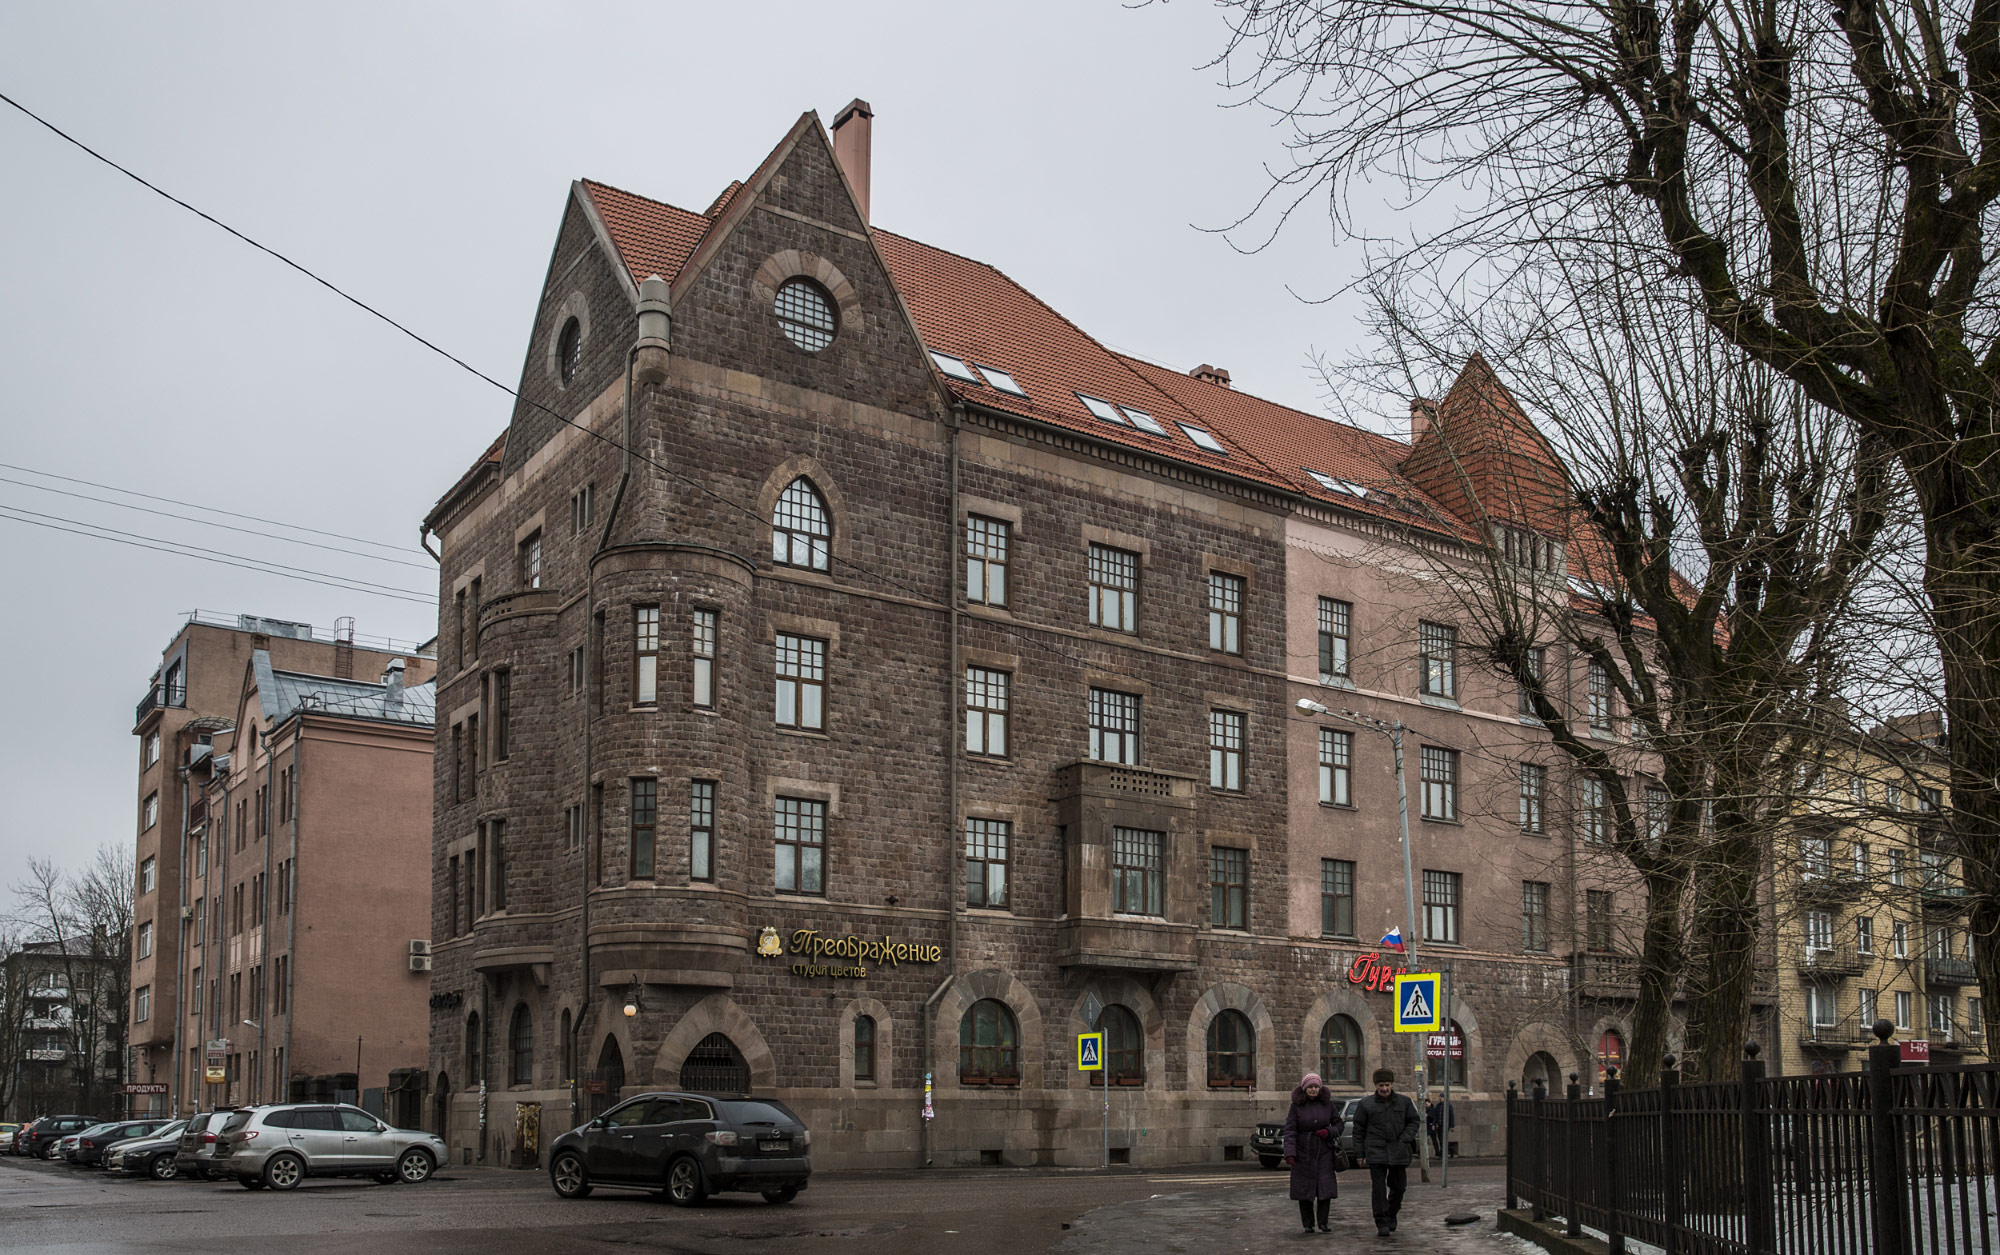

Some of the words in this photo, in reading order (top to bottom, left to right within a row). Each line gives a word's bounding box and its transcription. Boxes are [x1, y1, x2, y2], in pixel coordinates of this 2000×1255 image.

[790, 929, 941, 966] Преображение
[792, 963, 828, 977] студия
[830, 966, 866, 979] цветов
[126, 1084, 166, 1093] ПРОДУКТЫ
